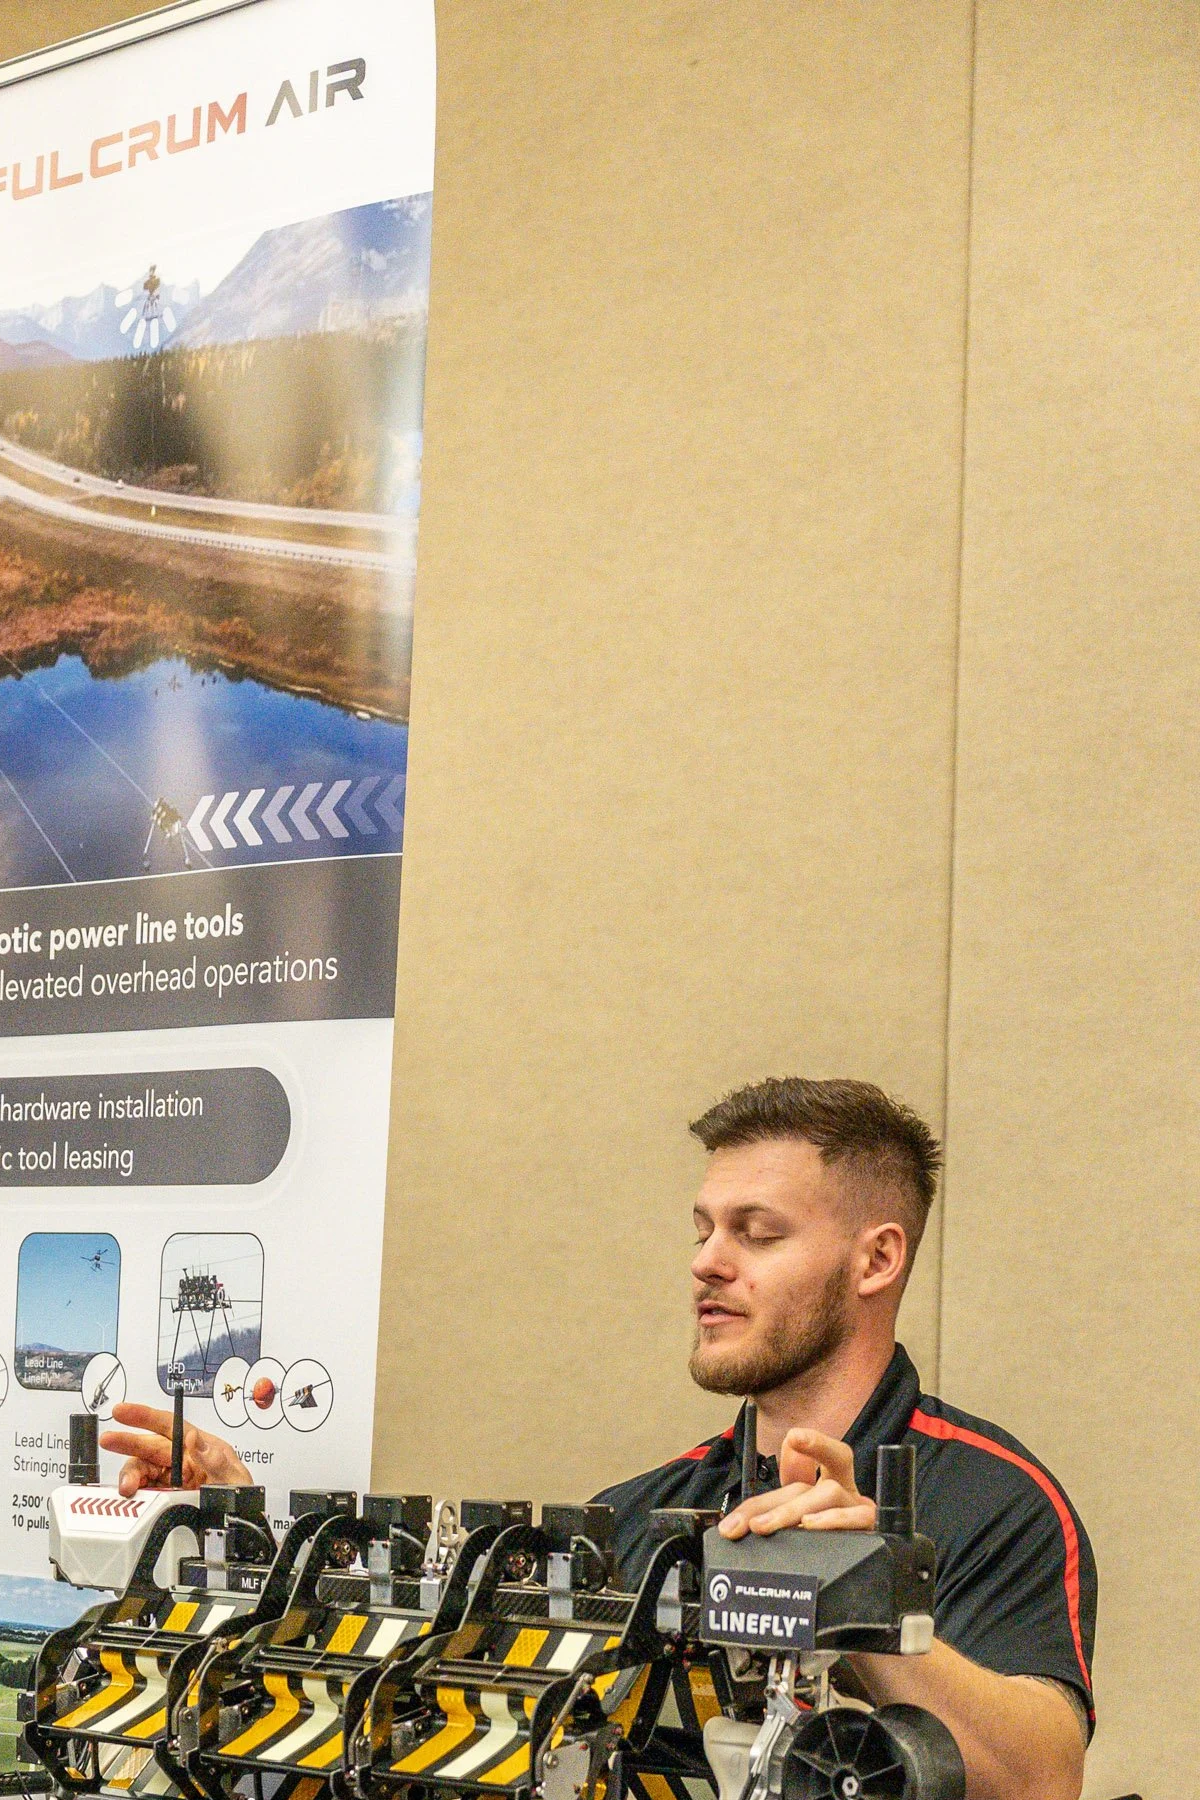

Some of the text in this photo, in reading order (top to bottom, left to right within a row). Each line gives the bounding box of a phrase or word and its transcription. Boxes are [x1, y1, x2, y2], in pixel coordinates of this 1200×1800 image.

[265, 57, 367, 127] AIR
[49, 921, 129, 960] power
[135, 911, 177, 946] line
[184, 902, 245, 939] tools
[91, 956, 197, 996] overhead
[204, 950, 339, 998] operations
[0, 1092, 92, 1122] hardware
[97, 1089, 204, 1120] installation
[17, 1141, 57, 1171] tool
[63, 1140, 135, 1177] leasing
[24, 1356, 64, 1370] Lead Line
[168, 1362, 186, 1375] BFD
[14, 1431, 70, 1450] Lead Line
[13, 1455, 67, 1479] Stringing
[11, 1514, 25, 1528] 10
[241, 1576, 260, 1590] MLF
[735, 1585, 813, 1601] FULCRUM AIR
